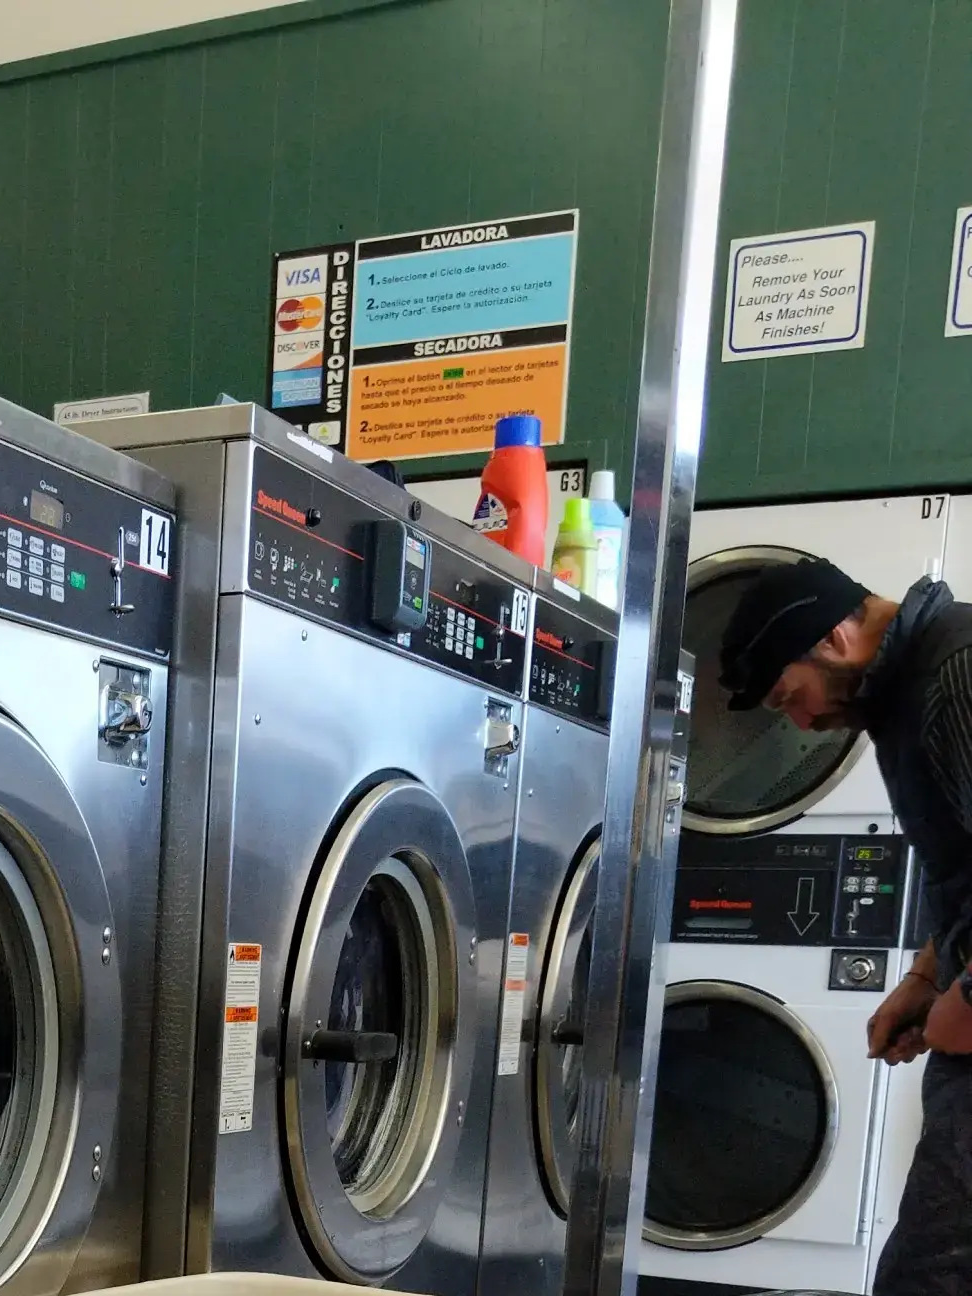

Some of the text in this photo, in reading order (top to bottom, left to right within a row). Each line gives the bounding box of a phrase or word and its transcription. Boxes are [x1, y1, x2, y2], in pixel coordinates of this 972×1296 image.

[420, 224, 508, 250] LAVADORA
[286, 267, 320, 286] VISA
[368, 274, 380, 286] 1.
[382, 272, 427, 285] Seleccione
[430, 270, 438, 278] el
[440, 267, 462, 278] Ciclo
[464, 265, 476, 274] de
[752, 267, 846, 289] Remove Your
[366, 298, 379, 310] 2.
[381, 298, 411, 309] Deslice
[414, 297, 424, 305] su
[426, 292, 454, 304] tarjeta
[456, 291, 466, 300] de
[502, 286, 508, 294] o
[510, 284, 521, 293] su
[524, 280, 552, 291] tarjeta
[738, 283, 856, 308] Laundry As Soon
[432, 304, 461, 315] Espere
[754, 304, 834, 323] As Machine
[326, 251, 348, 414] DIRECCIONES
[762, 322, 825, 340] Finishes!
[277, 340, 320, 354] DISCOVER
[414, 334, 503, 357] SECADORA
[363, 376, 376, 388] 1.
[376, 376, 405, 388] Oprima
[408, 374, 415, 384] el
[489, 364, 512, 374] lector
[514, 363, 525, 372] de
[527, 360, 558, 371] tarjetas
[361, 389, 382, 400] hasta
[384, 389, 400, 398] que
[402, 387, 409, 395] el
[410, 384, 436, 395] precio
[455, 380, 484, 390] tiempo
[486, 375, 520, 386] deseado
[523, 373, 534, 382] de
[361, 402, 389, 411] secado
[402, 397, 422, 408] haya
[360, 420, 372, 432] 2.
[418, 417, 442, 428] tarjeta
[445, 416, 454, 424] de
[421, 428, 449, 439] Espere
[460, 424, 495, 434] autoriza
[560, 472, 580, 492] G3
[921, 496, 946, 520] D7
[146, 516, 166, 570] 14
[514, 590, 526, 634] 15
[858, 849, 870, 859] 25
